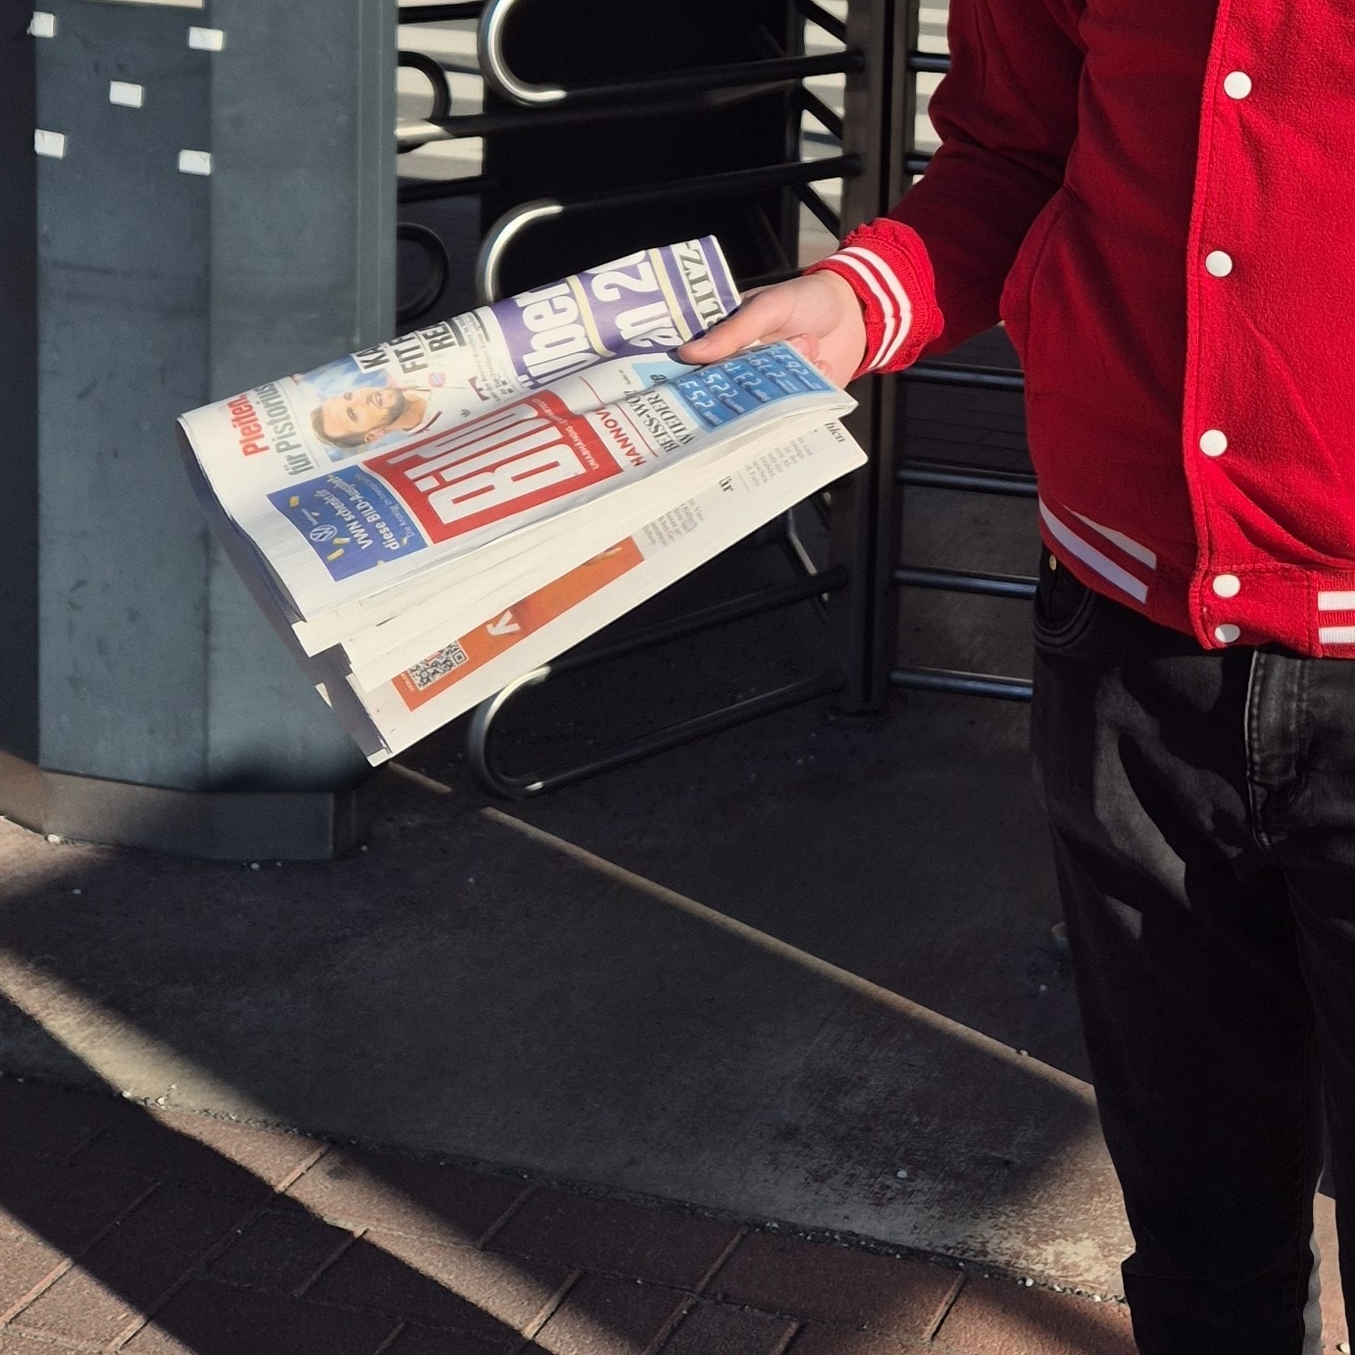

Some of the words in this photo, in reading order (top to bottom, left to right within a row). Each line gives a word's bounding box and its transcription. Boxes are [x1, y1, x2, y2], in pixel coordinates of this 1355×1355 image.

[393, 343, 429, 374] FIT
[254, 381, 302, 455] Pistorius
[623, 389, 681, 453] BEISS-WO
[284, 450, 314, 476] für
[386, 403, 588, 525] Bild
[346, 520, 373, 550] VWN
[375, 522, 399, 550] diese
